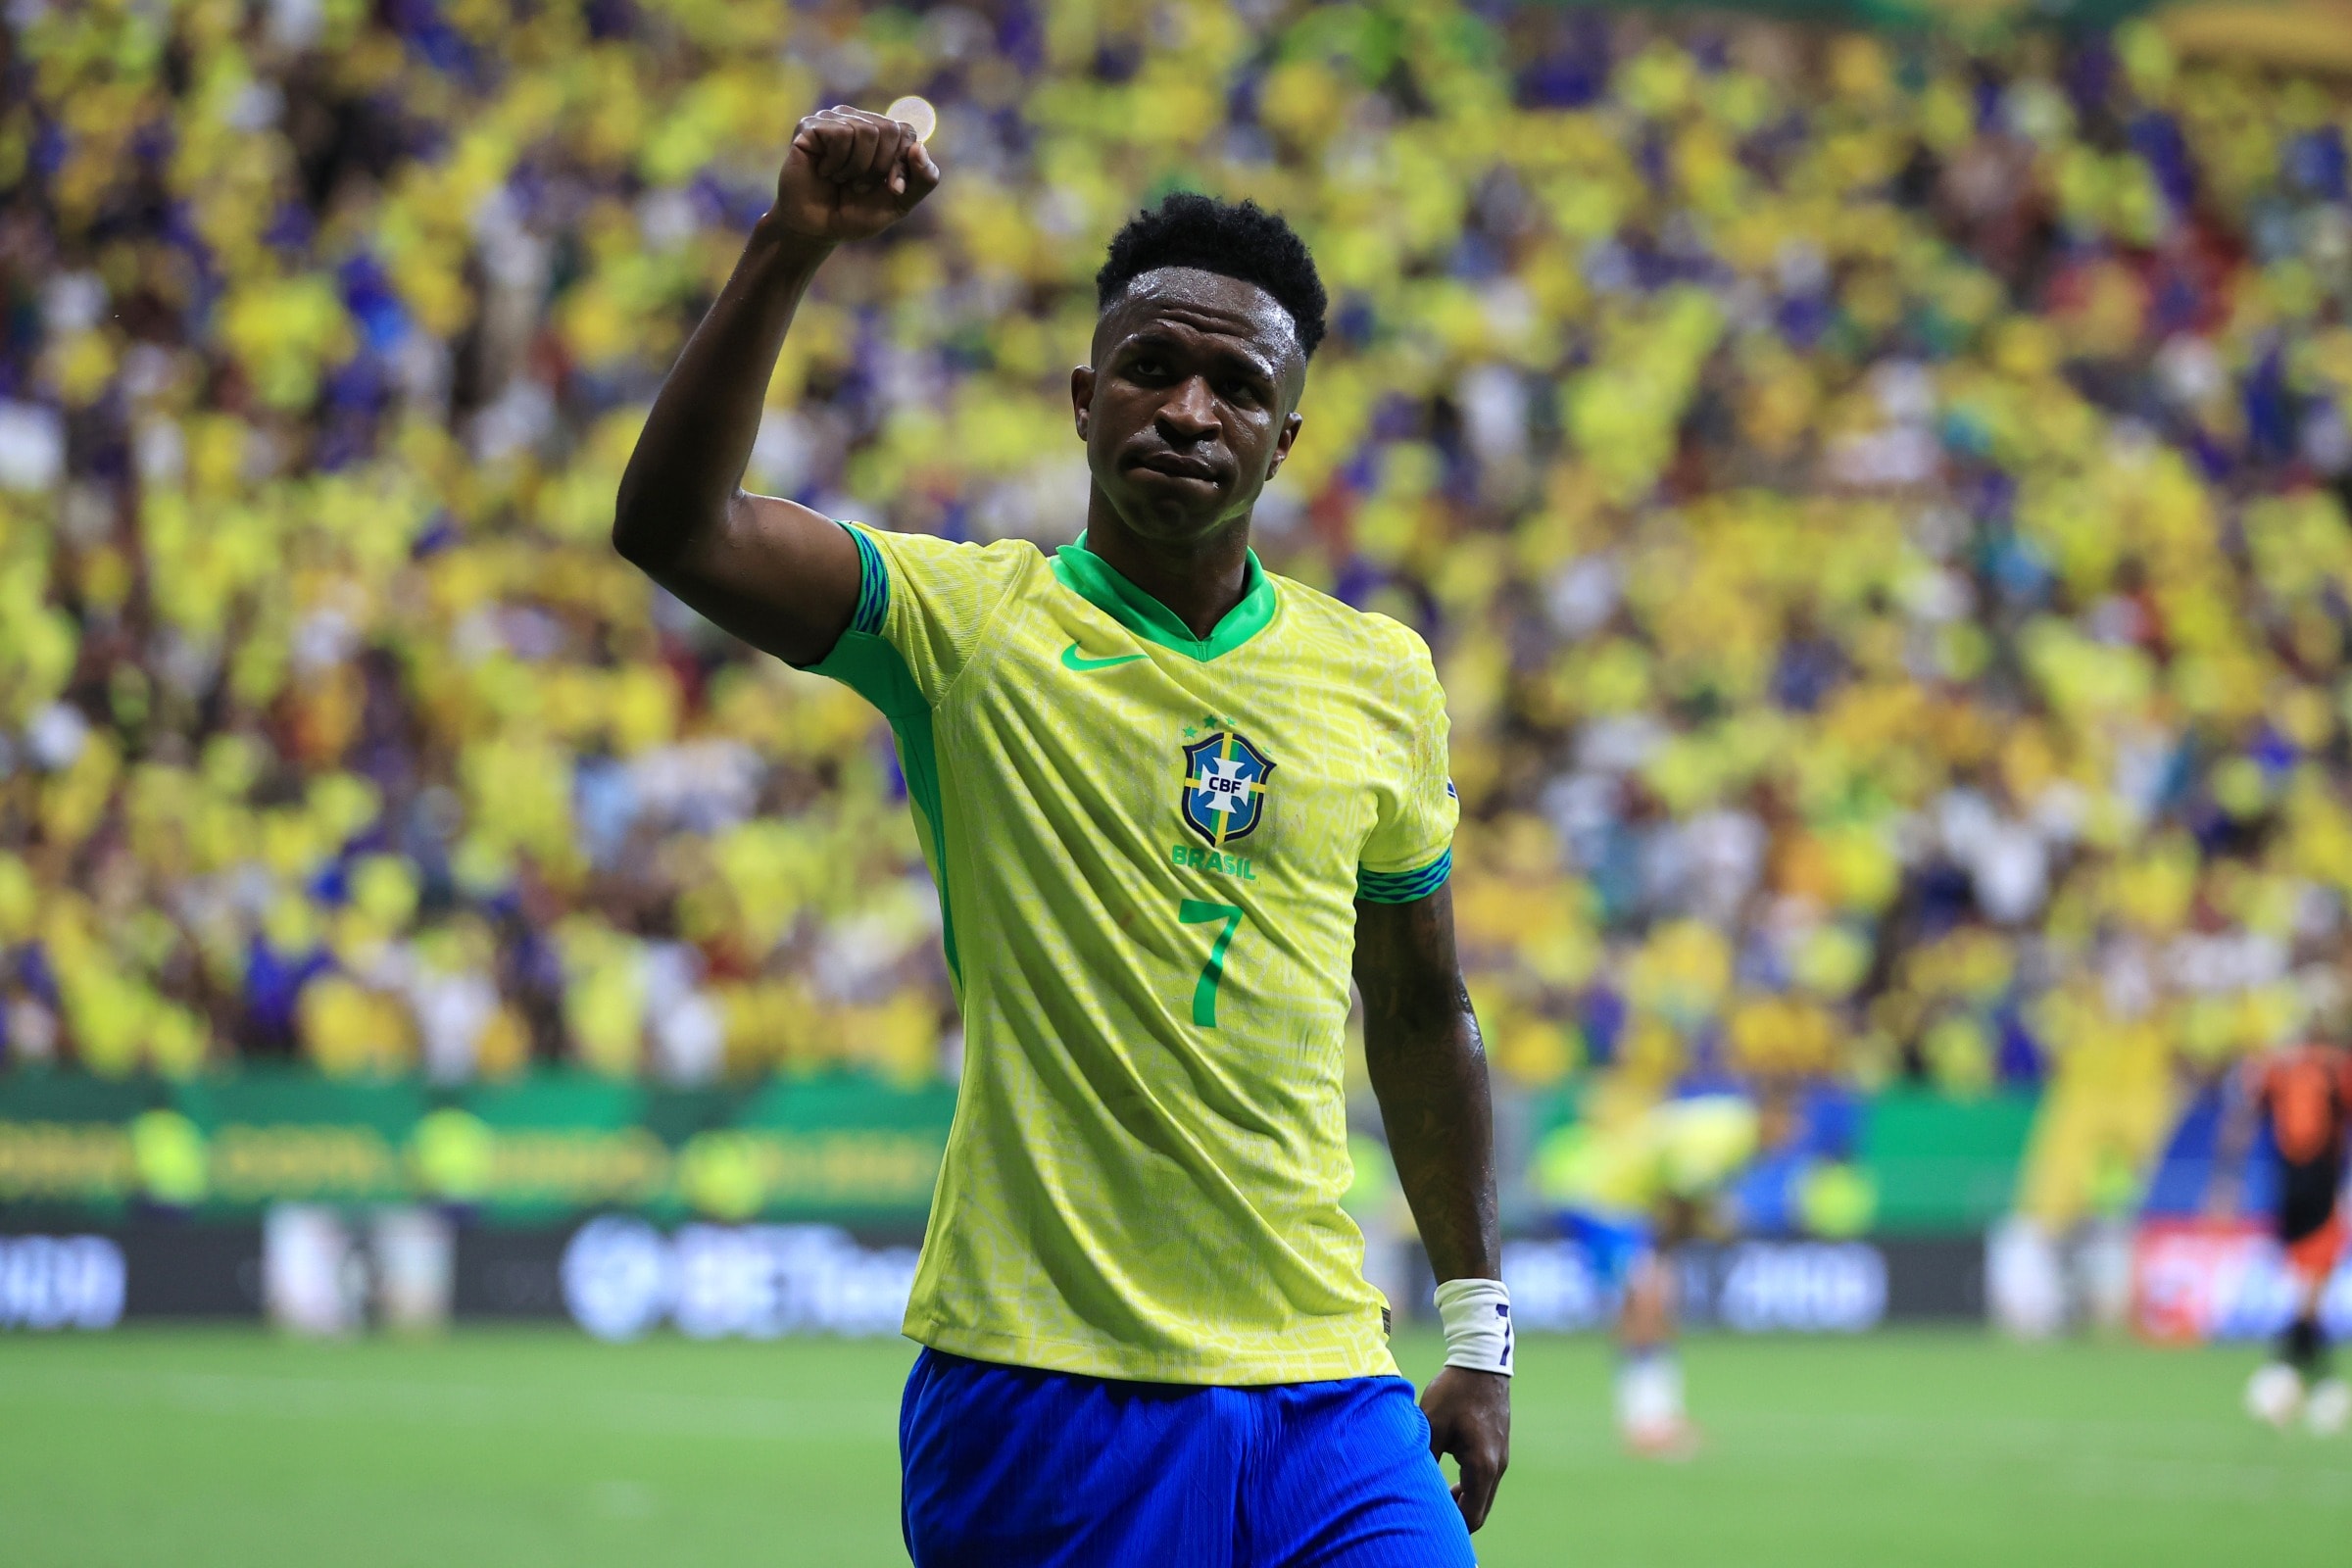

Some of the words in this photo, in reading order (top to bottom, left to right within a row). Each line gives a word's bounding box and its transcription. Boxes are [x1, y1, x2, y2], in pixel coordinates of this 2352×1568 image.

[1208, 776, 1243, 794] CBF
[1171, 845, 1256, 881] BRASIL
[1178, 898, 1245, 1028] 7
